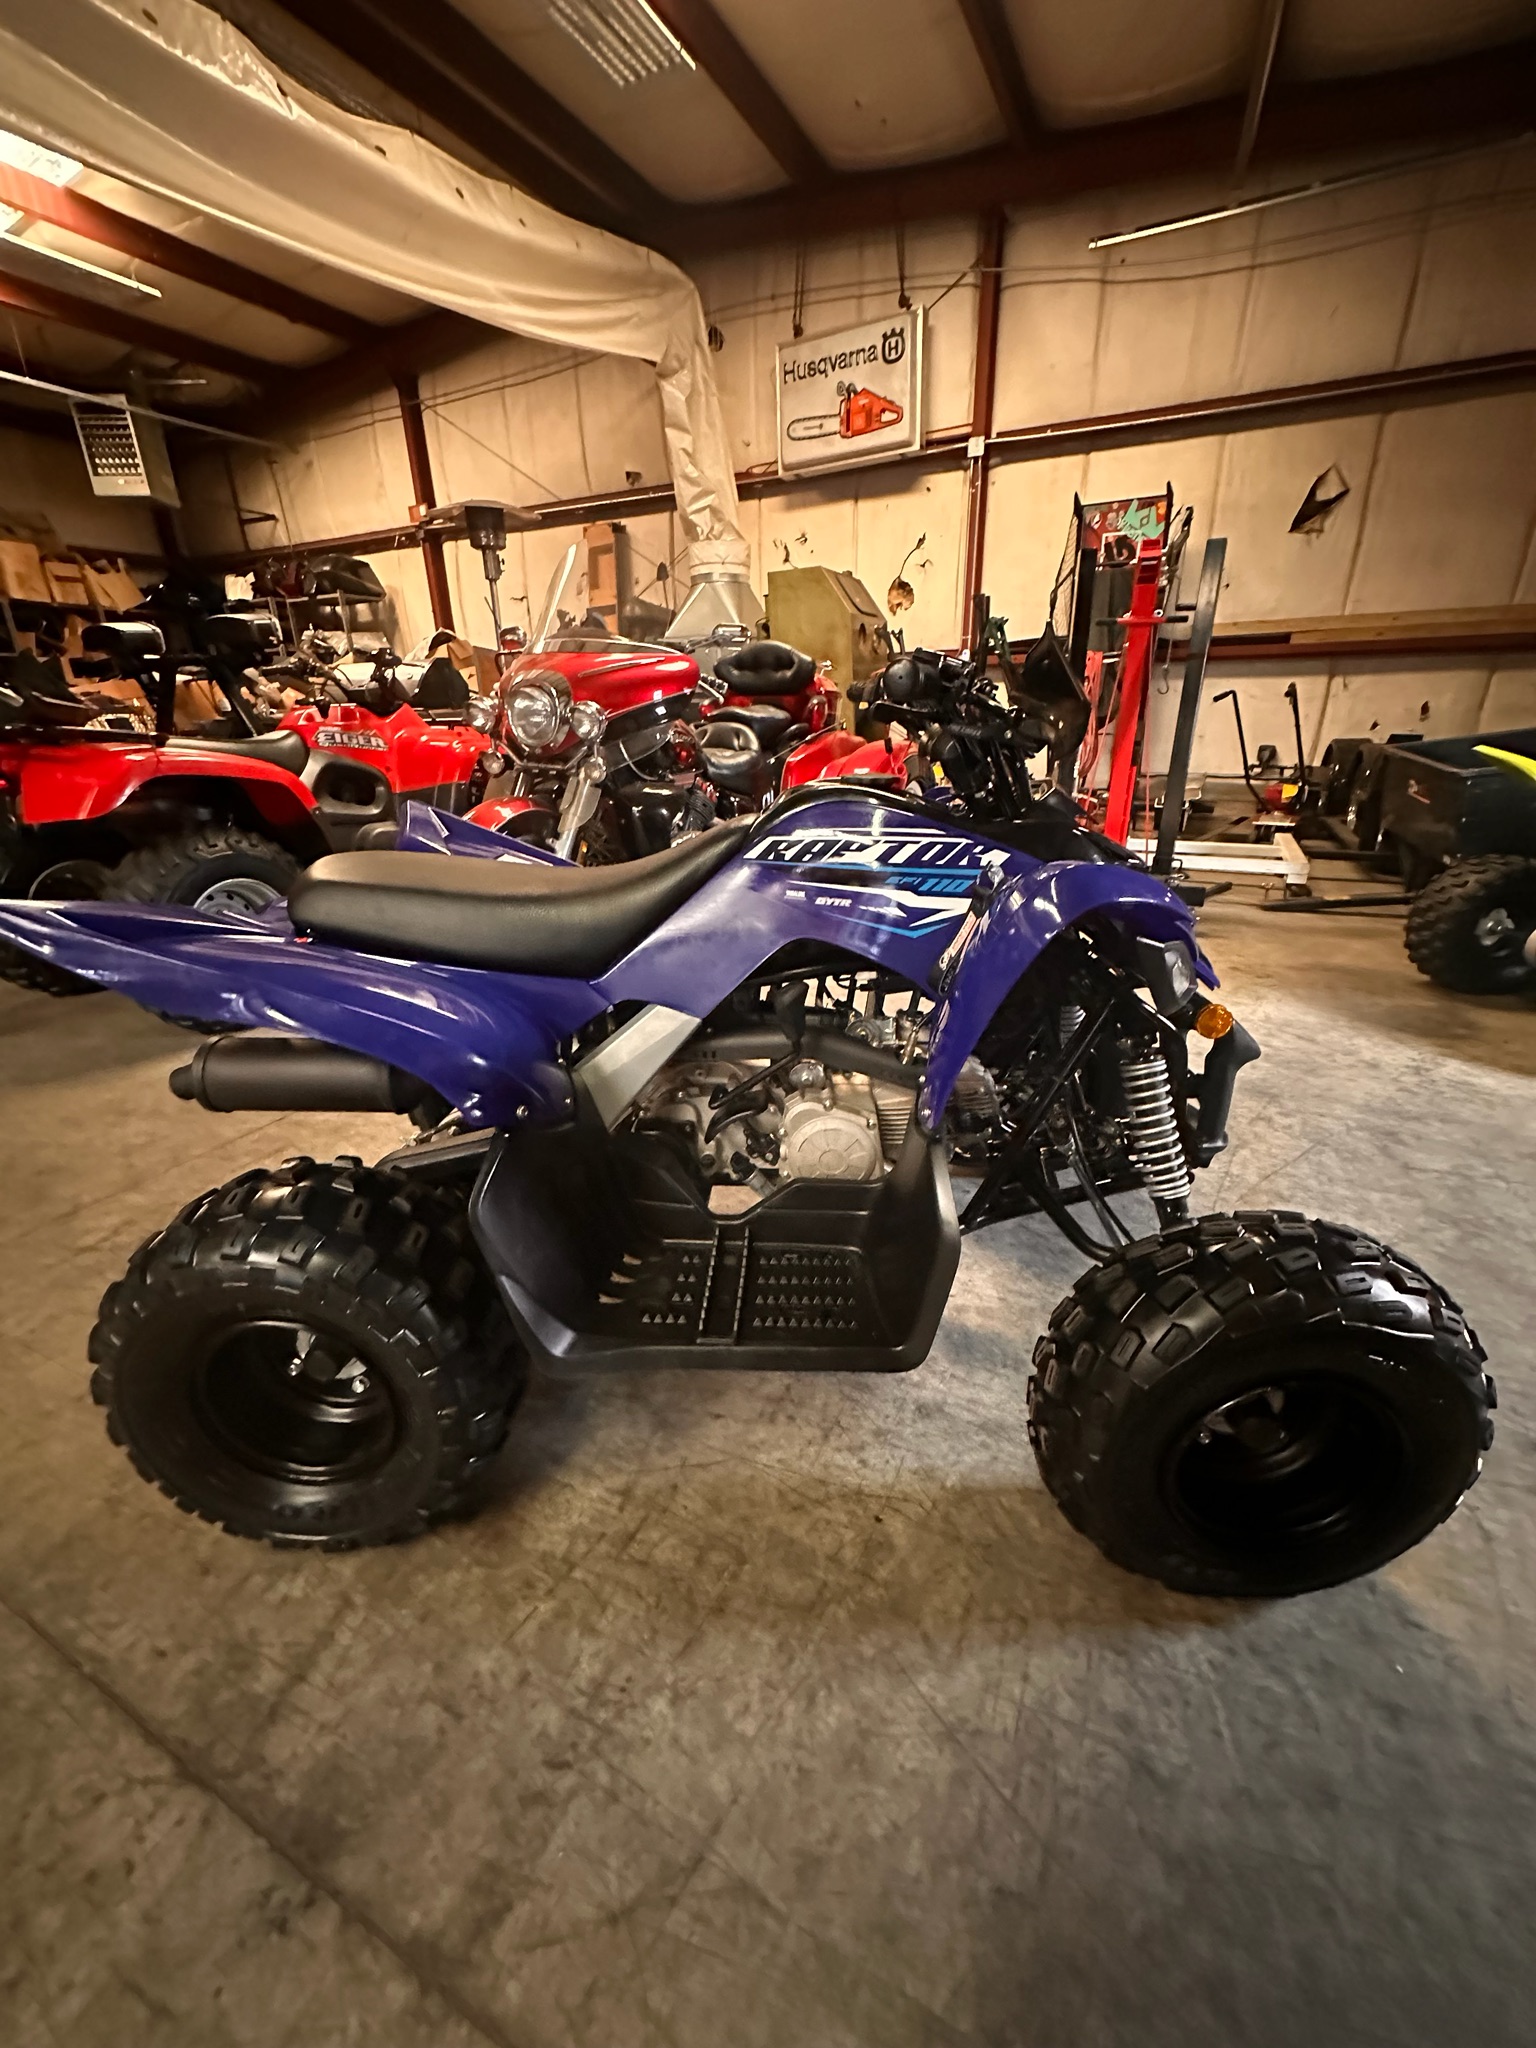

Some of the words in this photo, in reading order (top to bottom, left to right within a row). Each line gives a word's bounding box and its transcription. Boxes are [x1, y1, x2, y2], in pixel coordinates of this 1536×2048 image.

[783, 344, 879, 385] Husqvarna
[317, 732, 387, 748] EIGER
[754, 838, 988, 867] RAPTOR
[918, 878, 976, 893] 110
[814, 896, 852, 907] GYTR
